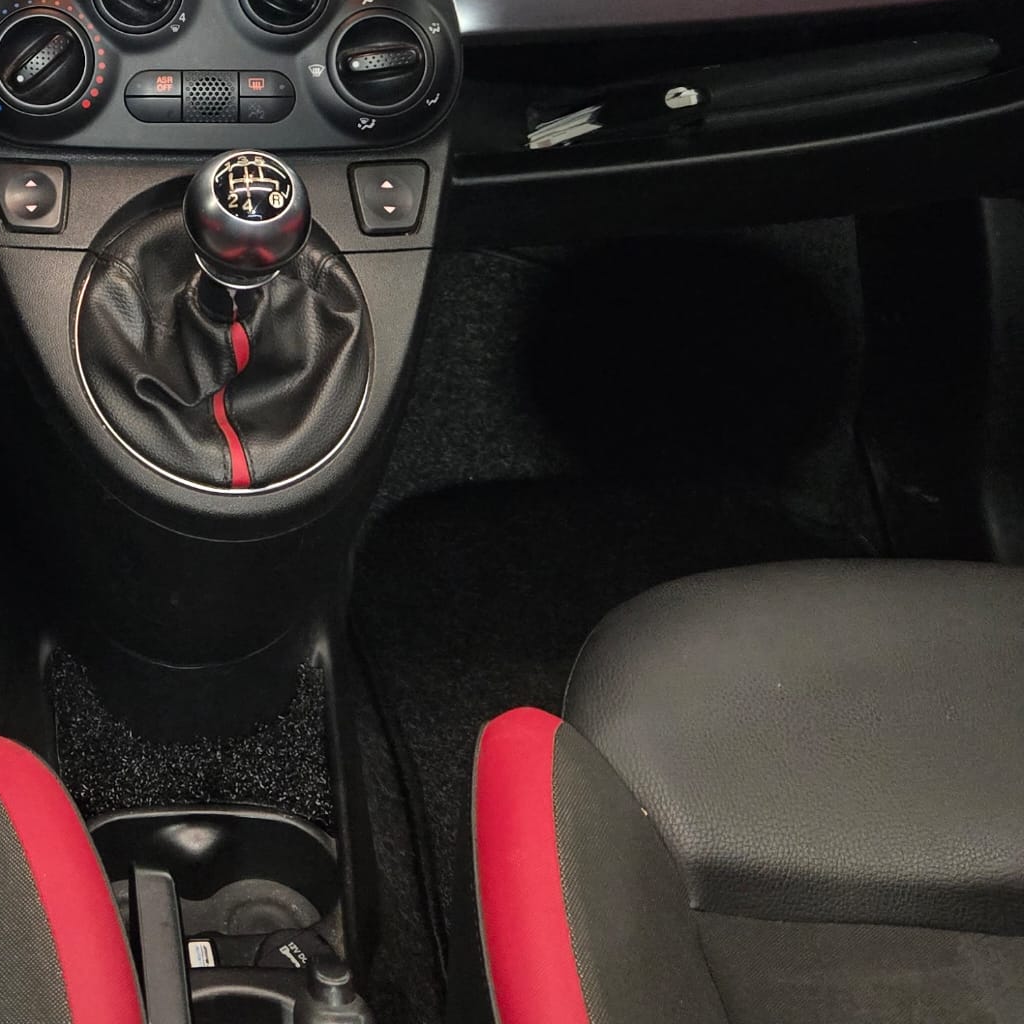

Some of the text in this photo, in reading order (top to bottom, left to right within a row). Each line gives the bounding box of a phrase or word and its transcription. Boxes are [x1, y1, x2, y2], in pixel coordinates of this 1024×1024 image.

[179, 12, 186, 22] 4
[157, 76, 173, 84] ASR
[157, 84, 173, 92] OFF
[228, 193, 238, 208] 2
[242, 198, 253, 214] 4
